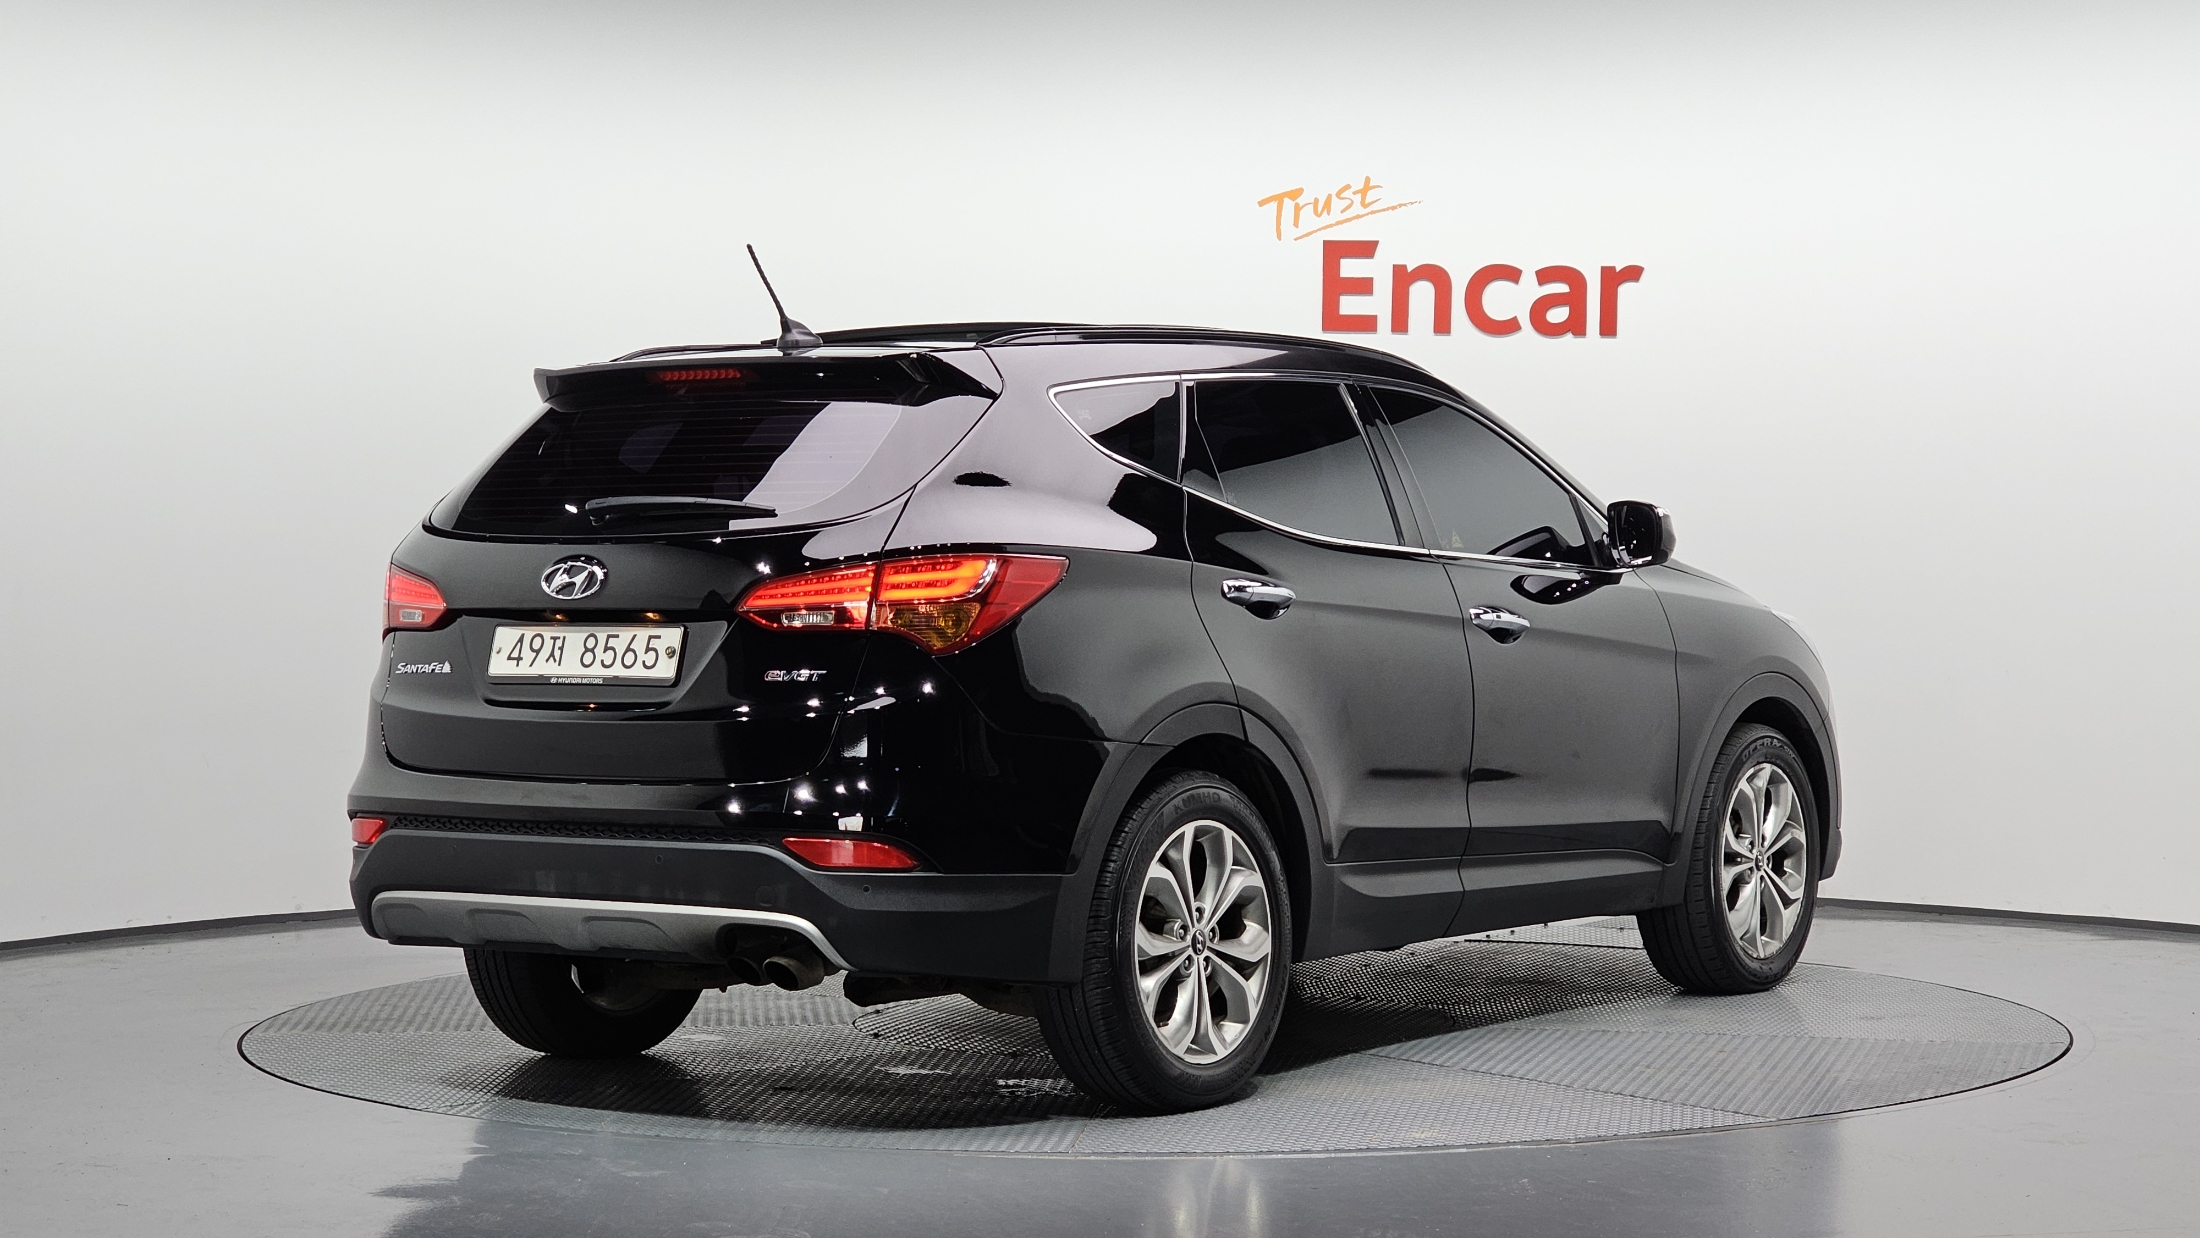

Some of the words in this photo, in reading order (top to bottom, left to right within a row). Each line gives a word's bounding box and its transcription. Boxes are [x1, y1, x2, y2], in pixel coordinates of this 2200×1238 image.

[1257, 175, 1384, 242] Trust
[1321, 239, 1646, 338] Encar
[506, 632, 567, 668] 49저
[579, 632, 662, 670] 8565
[1173, 791, 1221, 815] KUMHO
